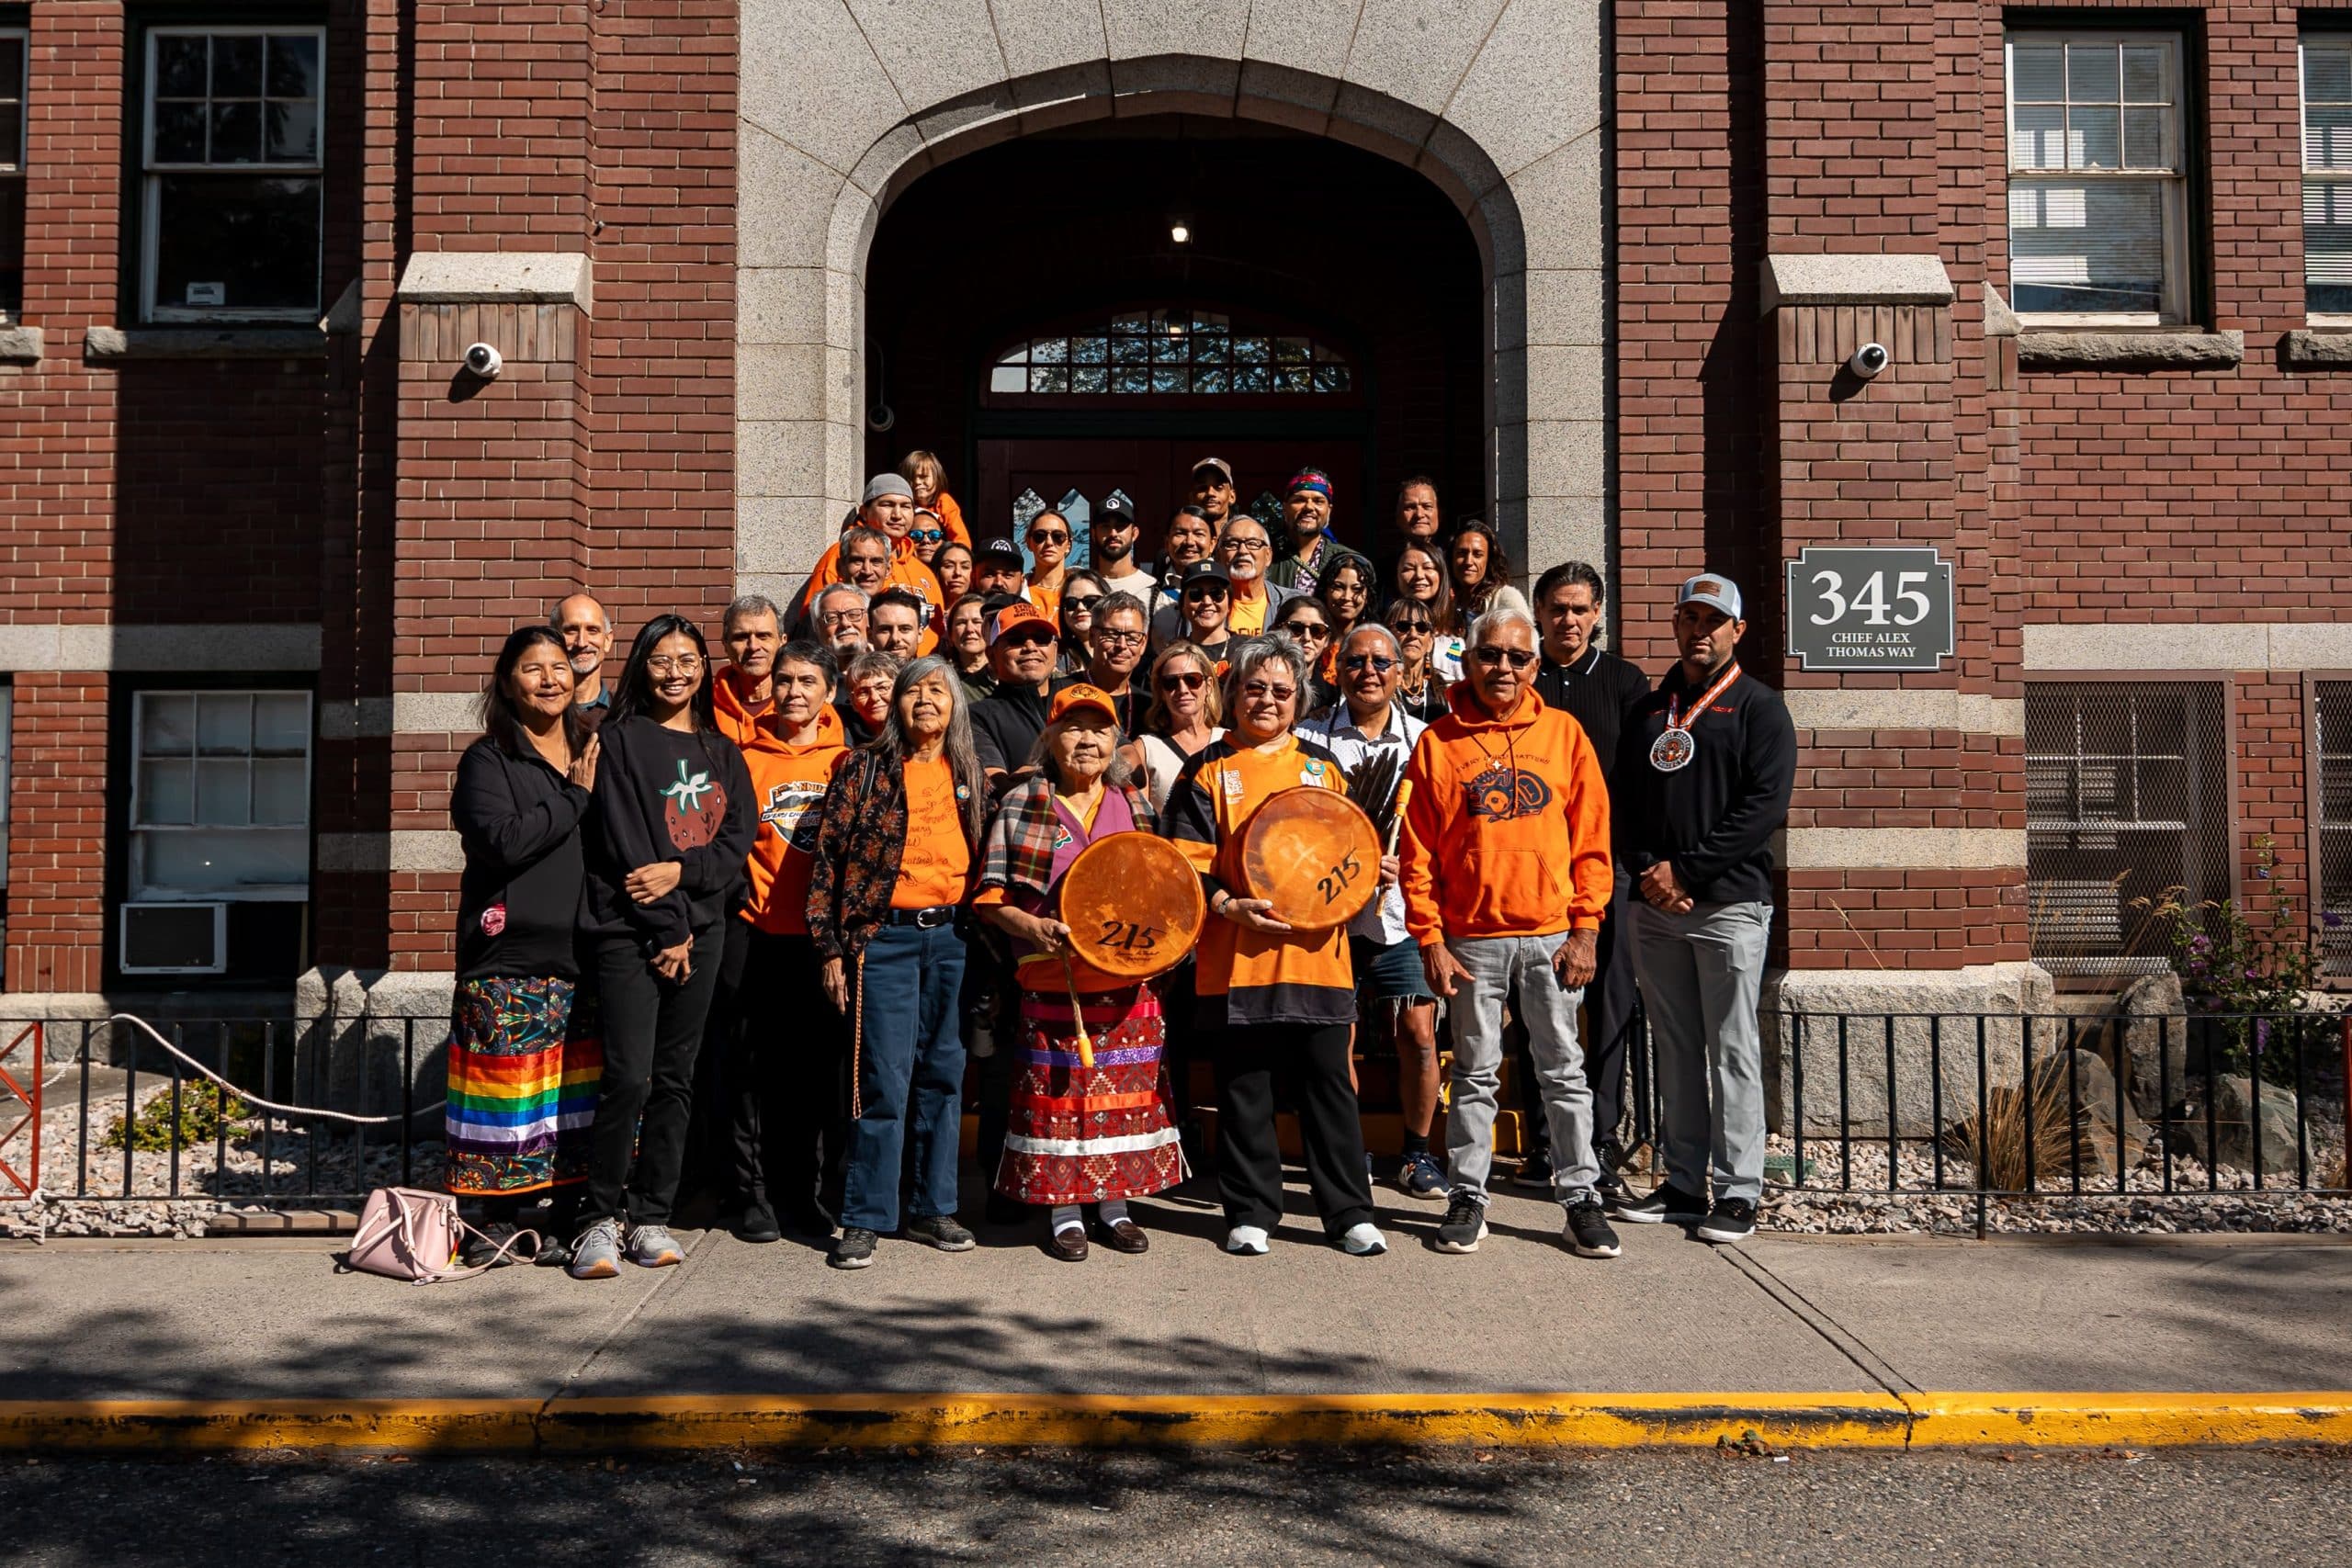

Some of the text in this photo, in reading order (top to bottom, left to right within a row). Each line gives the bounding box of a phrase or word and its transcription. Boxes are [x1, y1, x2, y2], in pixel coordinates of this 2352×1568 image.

[1810, 570, 1930, 626] 345
[1831, 632, 1911, 644] CHIEF ALEX
[1826, 646, 1917, 658] THOMAS WAY
[791, 782, 827, 794] ANNUA
[784, 818, 821, 827] HOCKE
[1317, 846, 1361, 906] 215
[1096, 920, 1168, 950] 215
